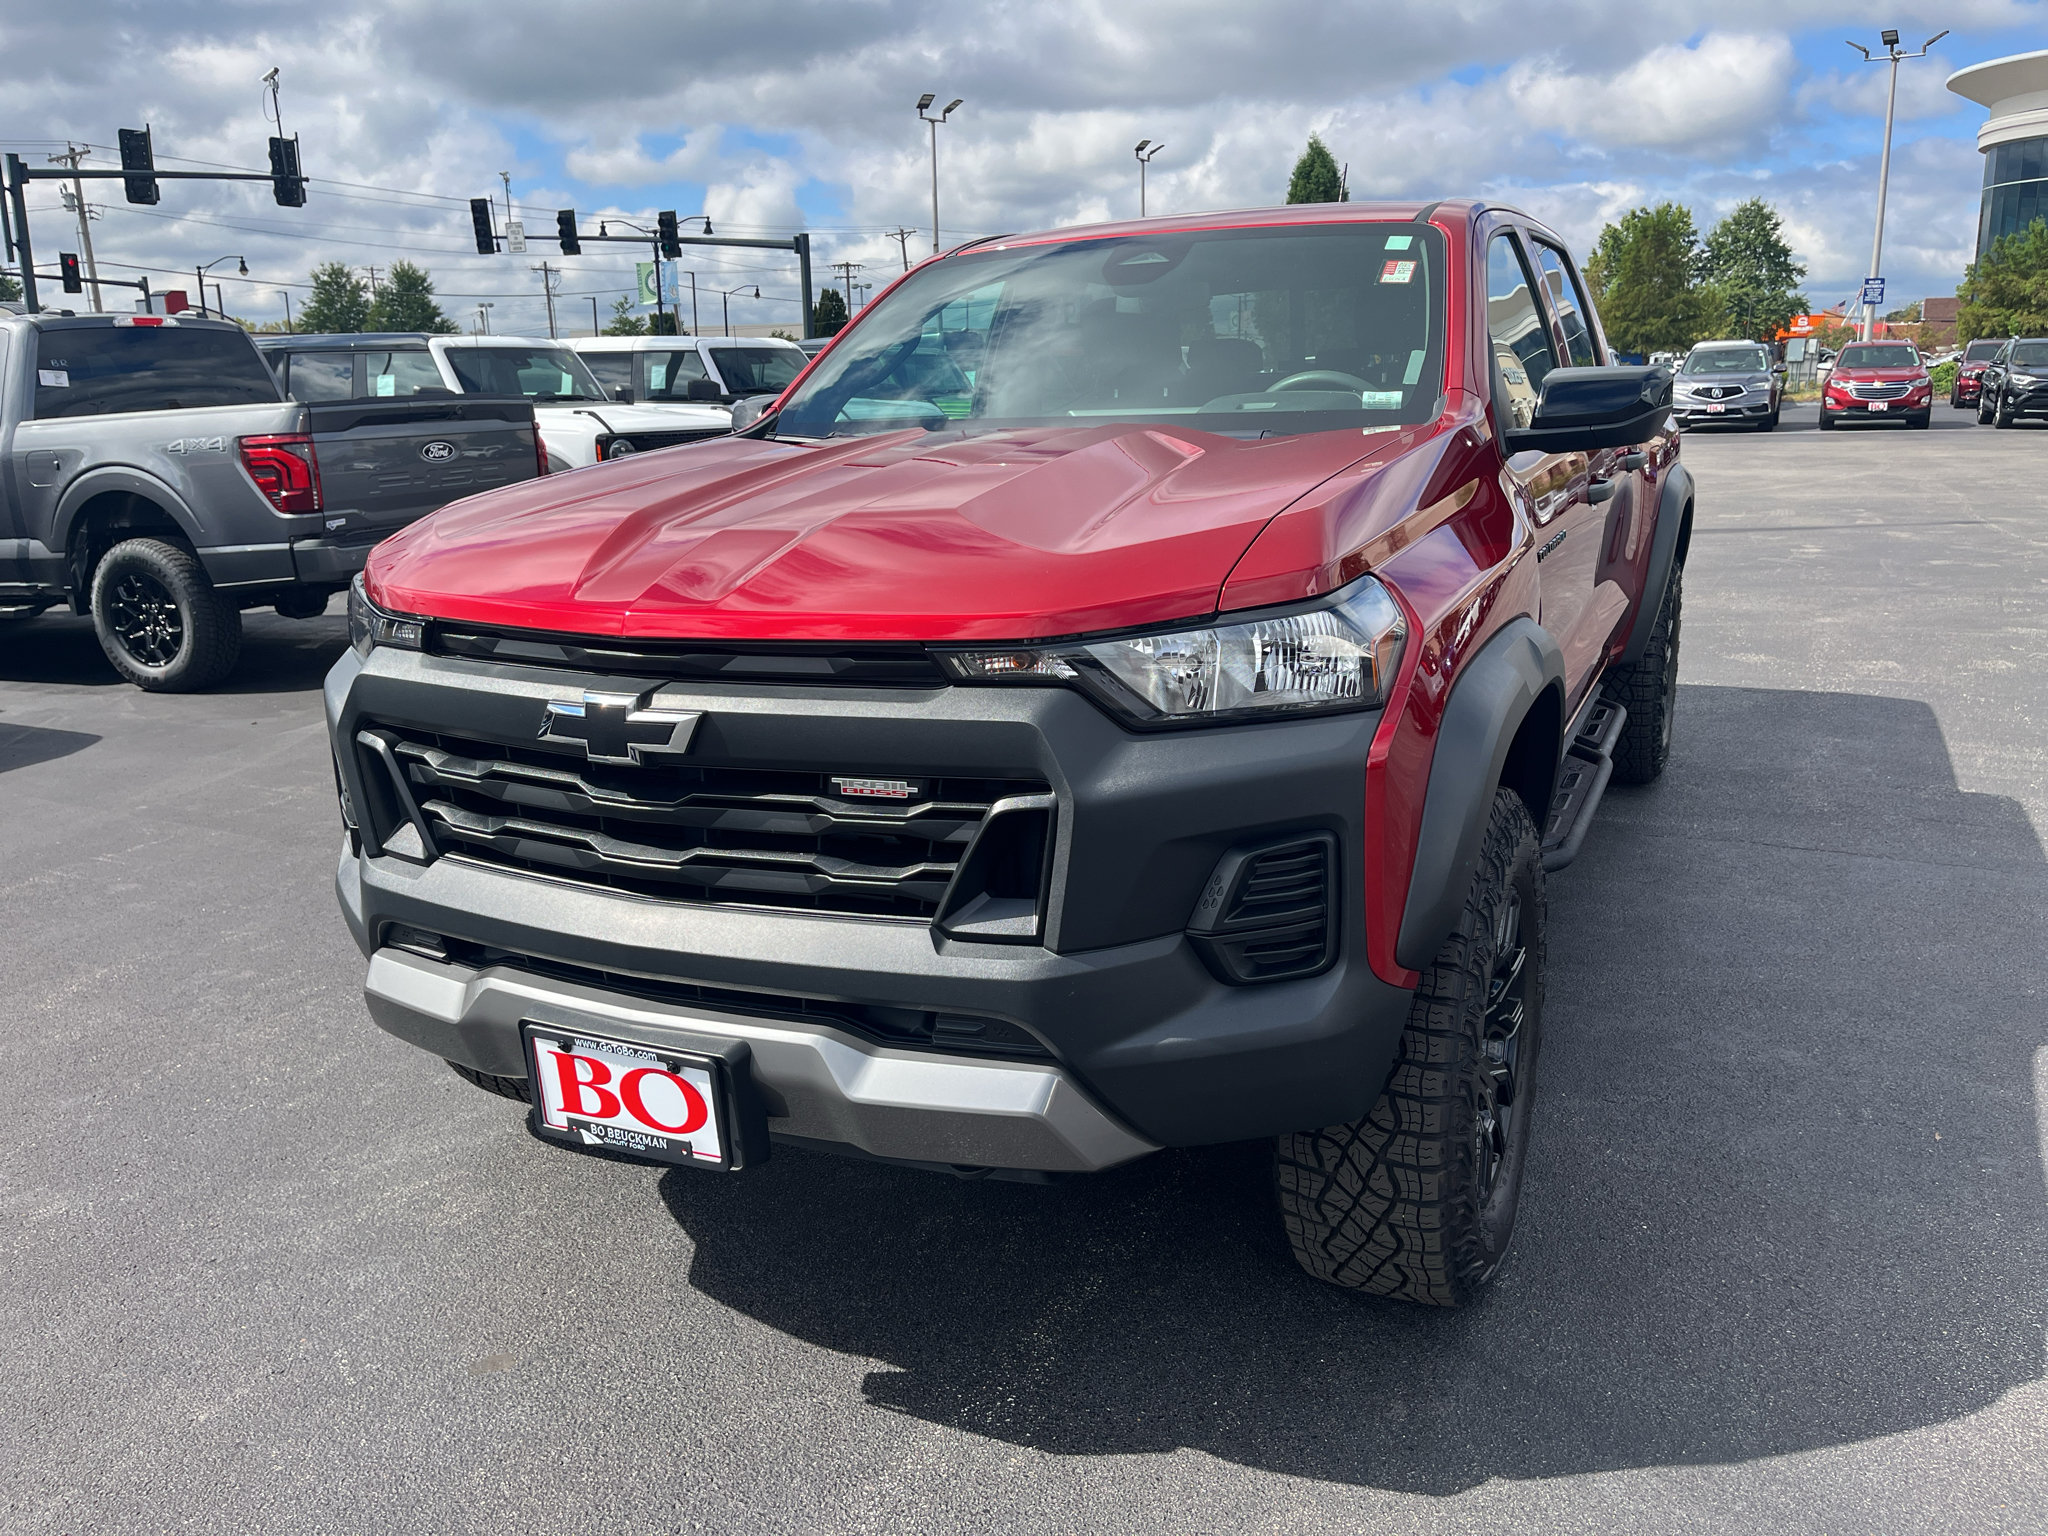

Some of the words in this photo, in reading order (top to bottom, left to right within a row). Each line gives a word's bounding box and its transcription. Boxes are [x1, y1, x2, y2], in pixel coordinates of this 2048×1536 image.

[428, 444, 449, 458] Ford
[831, 777, 918, 793] TRAIL
[842, 786, 907, 797] BOSS
[574, 1038, 658, 1062] www.GoToBo.com
[546, 1050, 708, 1135] BO
[590, 1123, 605, 1137] BO
[607, 1127, 668, 1150] BEUCKMAN
[603, 1137, 628, 1147] QUALITY
[629, 1142, 646, 1151] FORD
